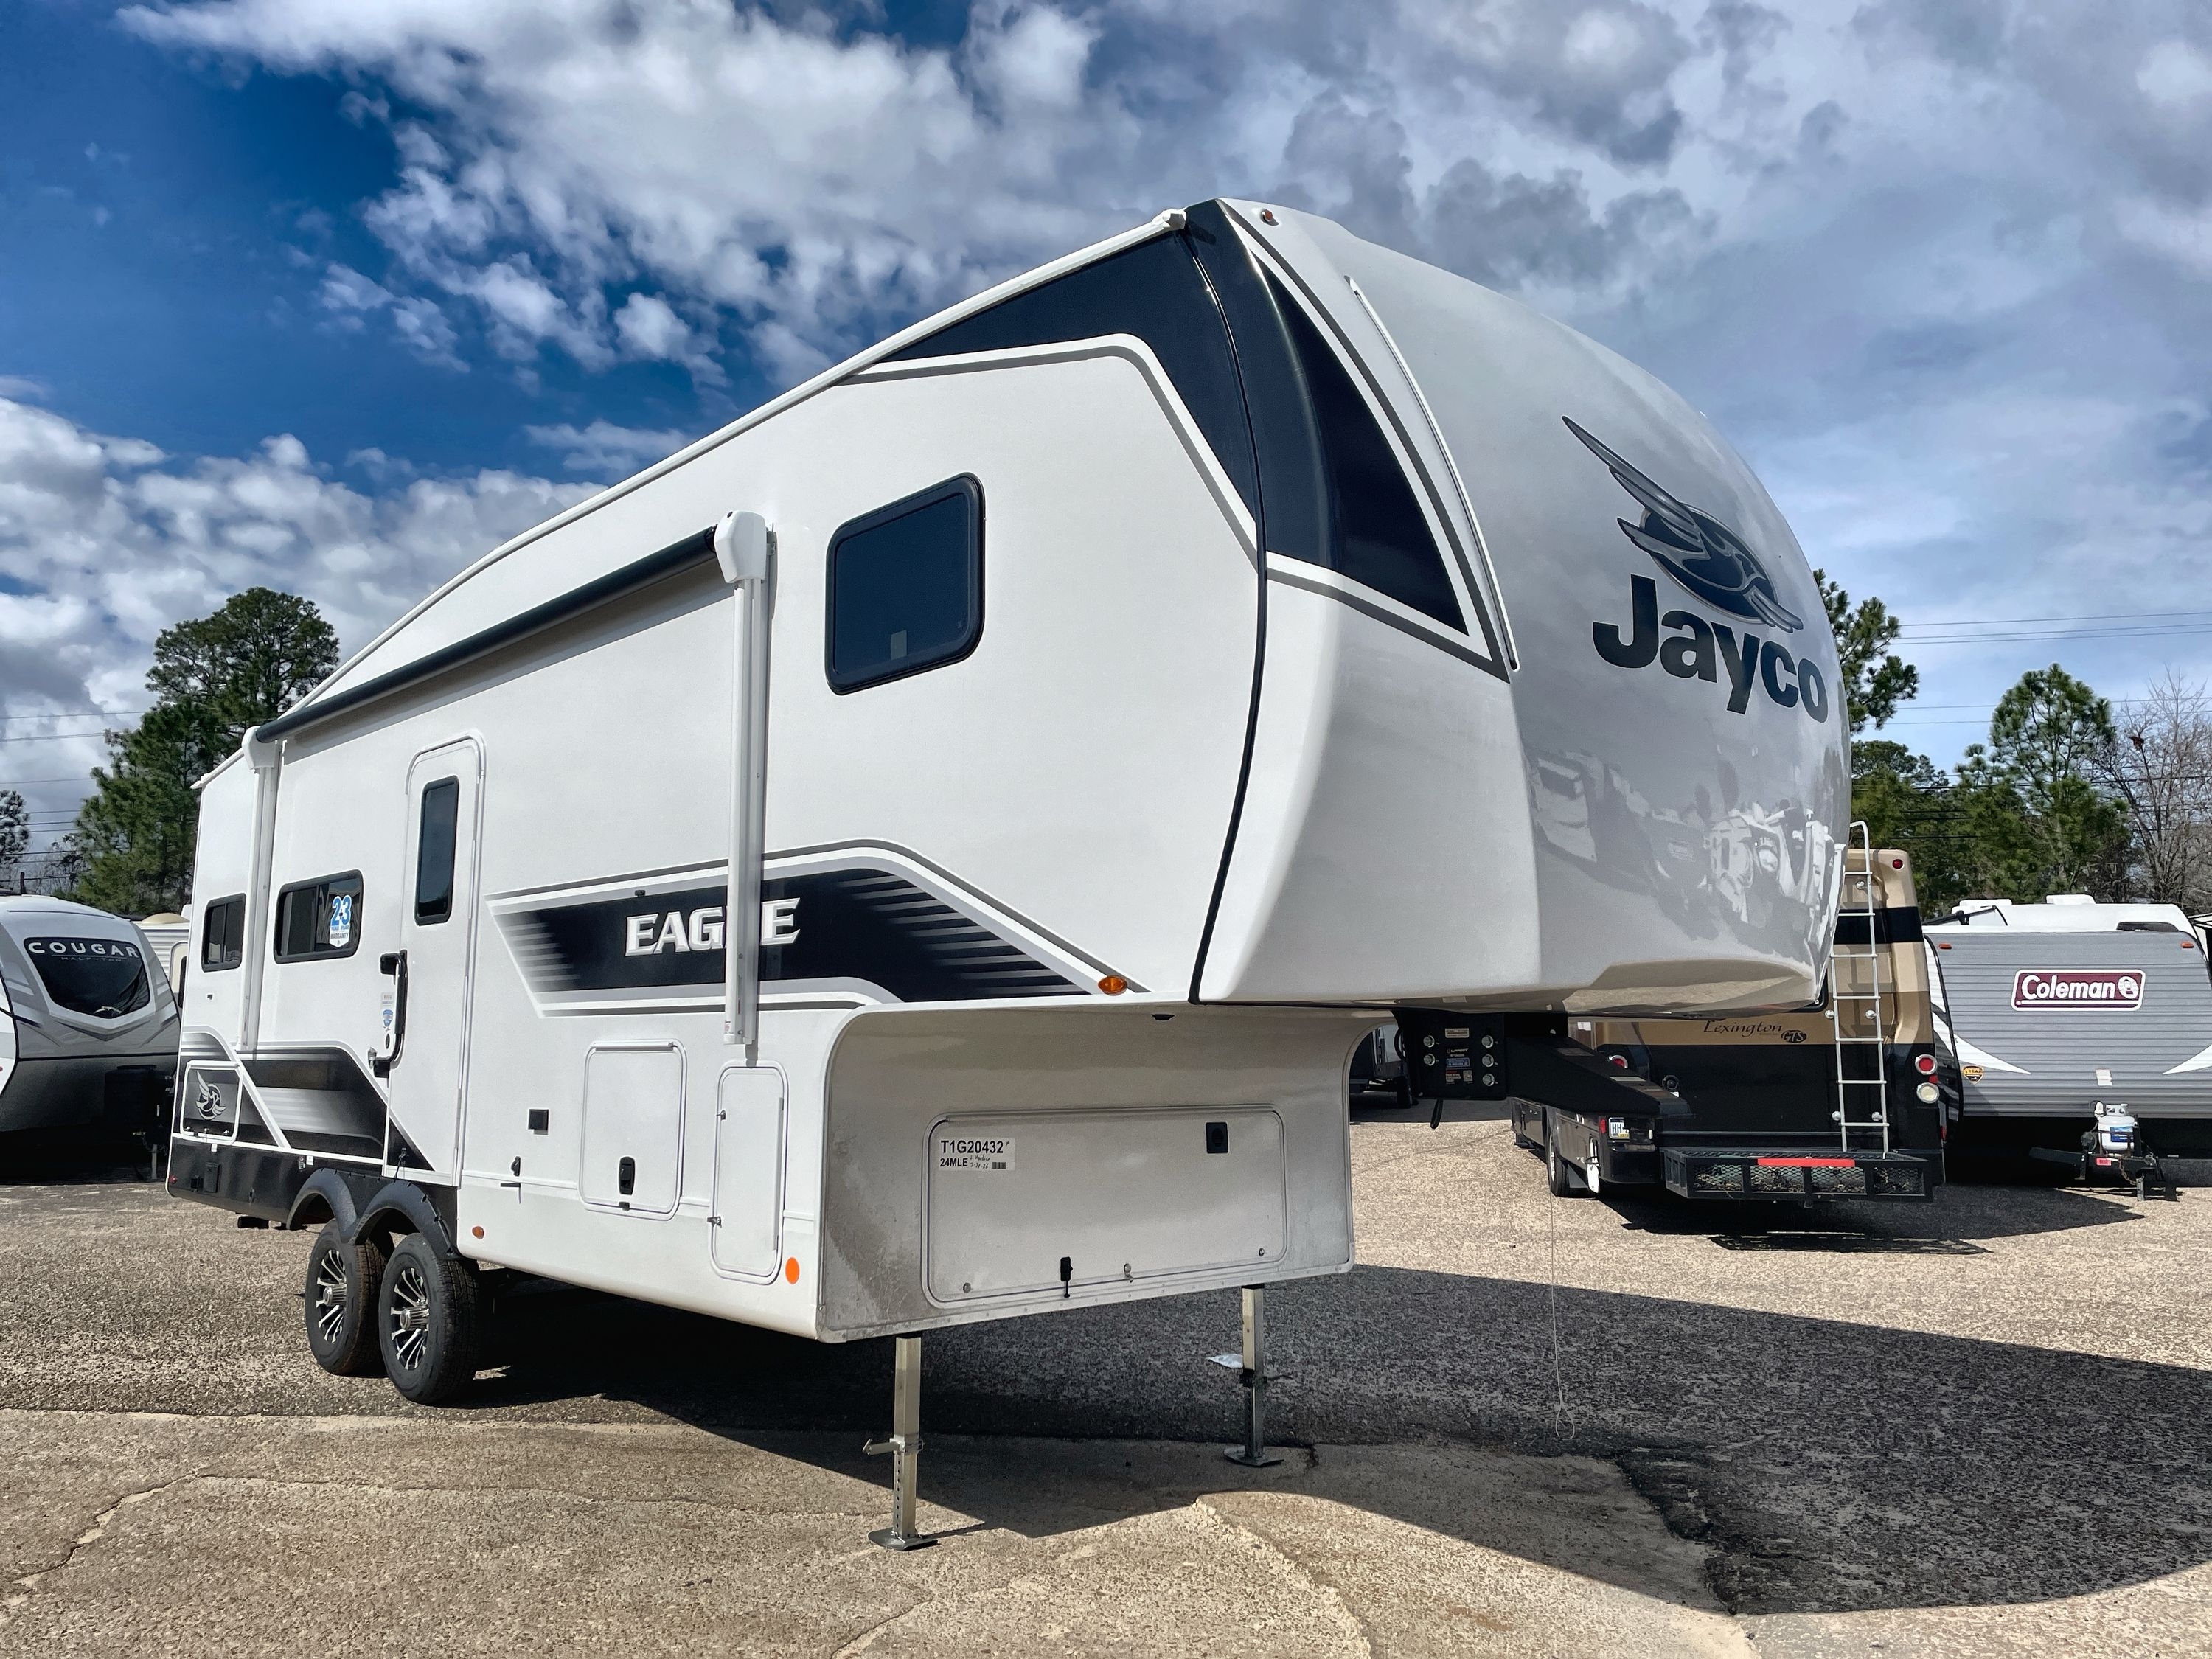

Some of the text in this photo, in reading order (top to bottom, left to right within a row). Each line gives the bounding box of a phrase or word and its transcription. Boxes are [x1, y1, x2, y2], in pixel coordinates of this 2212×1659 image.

[1592, 573, 1829, 723] Jayco
[625, 897, 801, 957] EAGE
[28, 942, 139, 958] COUGAR
[2021, 974, 2116, 1001] Coleman
[1703, 1020, 1806, 1042] Lexington GTS
[940, 1140, 1004, 1154] T1G20432
[939, 1158, 968, 1167] 24MLE
